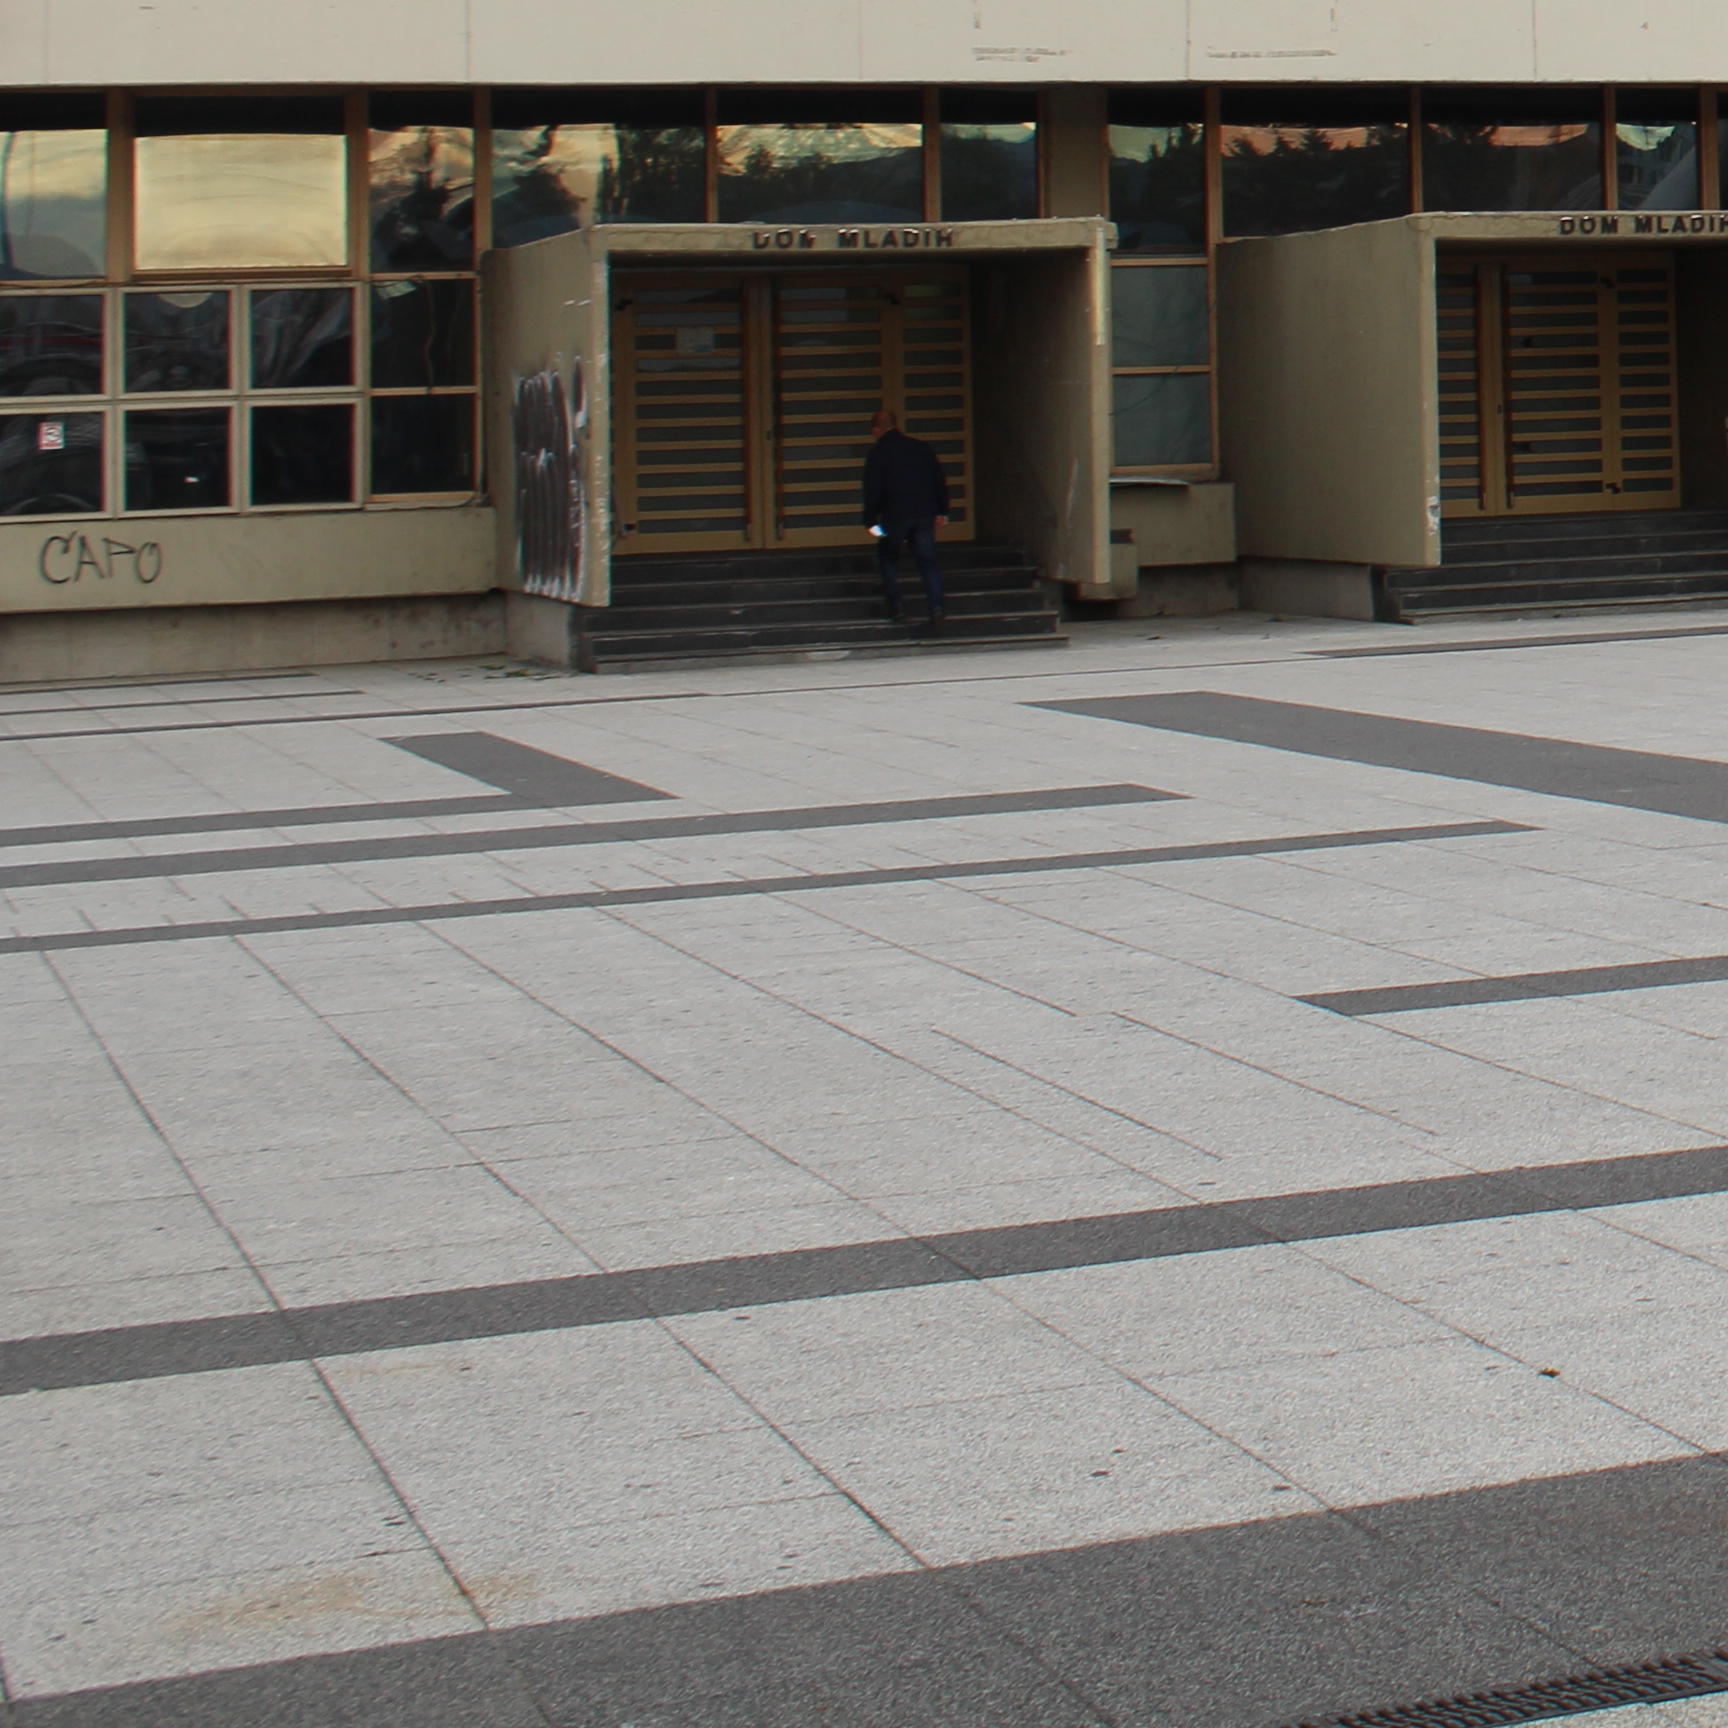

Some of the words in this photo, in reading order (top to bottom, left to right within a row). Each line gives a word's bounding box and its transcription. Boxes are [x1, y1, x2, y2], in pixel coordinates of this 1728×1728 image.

[1559, 216, 1618, 235] DOM
[837, 228, 955, 249] MLADIH
[40, 530, 163, 584] CAPO
